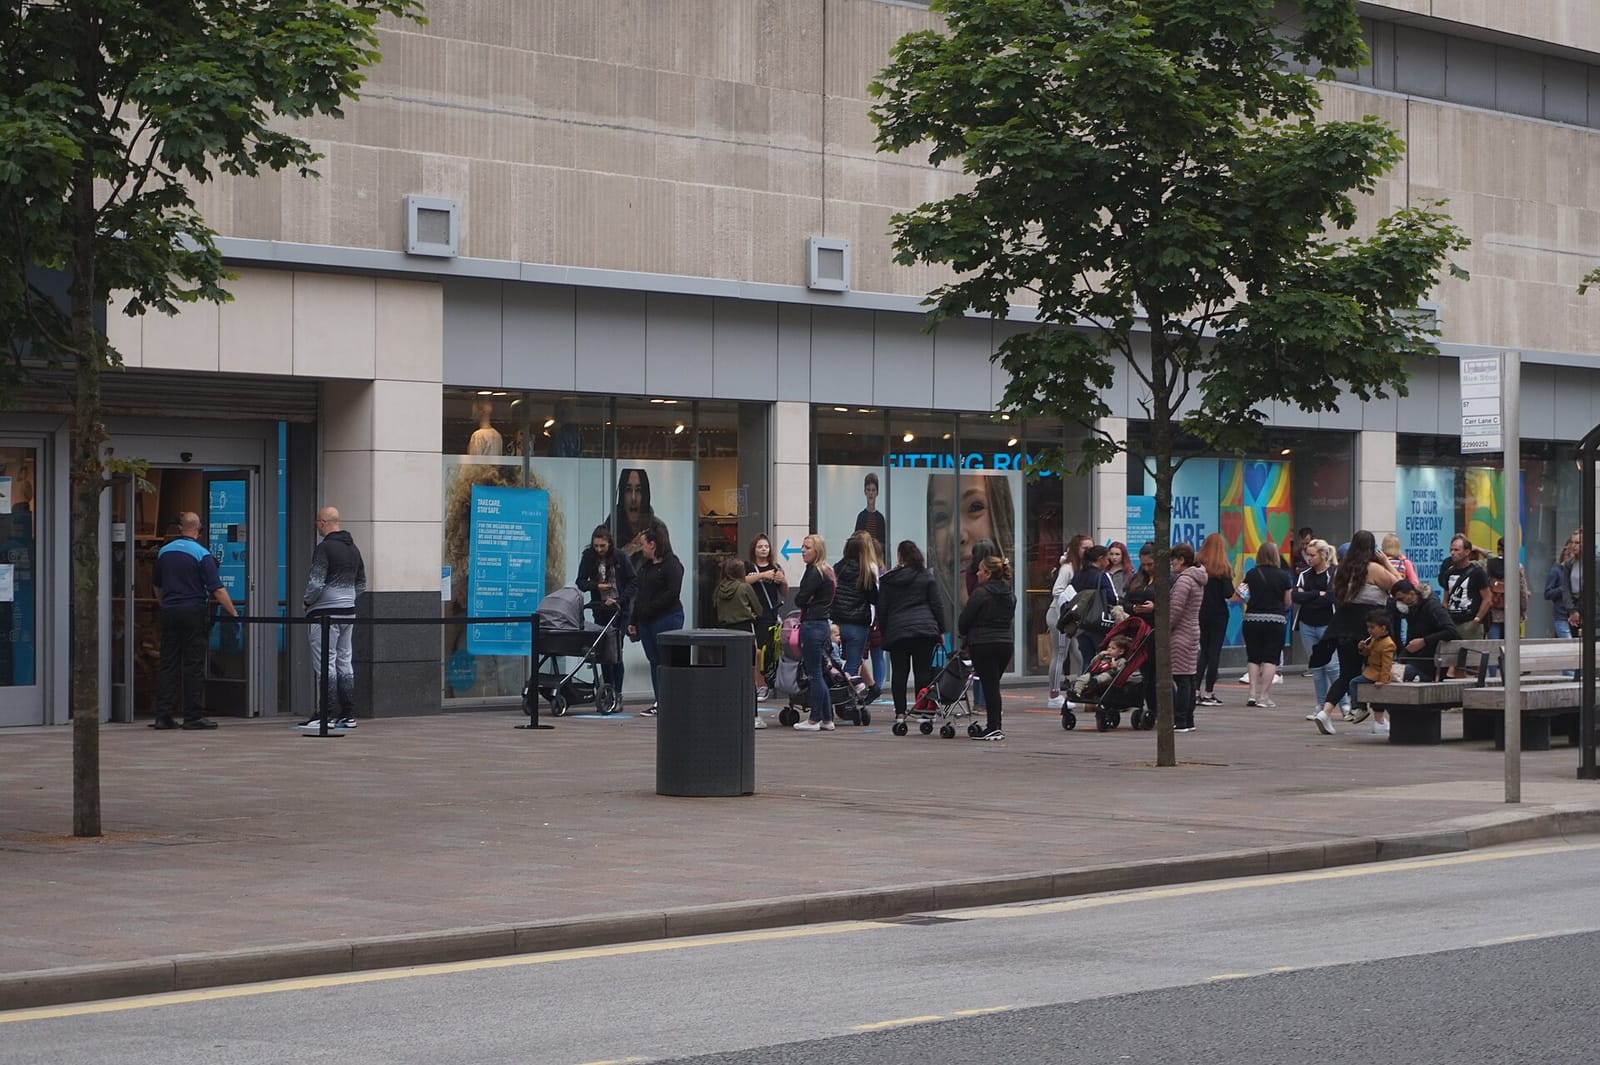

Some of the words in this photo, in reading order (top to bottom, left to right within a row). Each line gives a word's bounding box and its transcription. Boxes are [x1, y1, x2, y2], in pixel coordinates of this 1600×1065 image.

[1172, 496, 1200, 519] AKE
[1411, 500, 1421, 514] TO
[1423, 500, 1438, 514] OUR
[1406, 516, 1443, 531] EVERYDAY
[1172, 523, 1205, 552] ARE
[1410, 532, 1438, 546] HEROES
[1405, 548, 1428, 562] THERE
[1429, 548, 1444, 562] ARE
